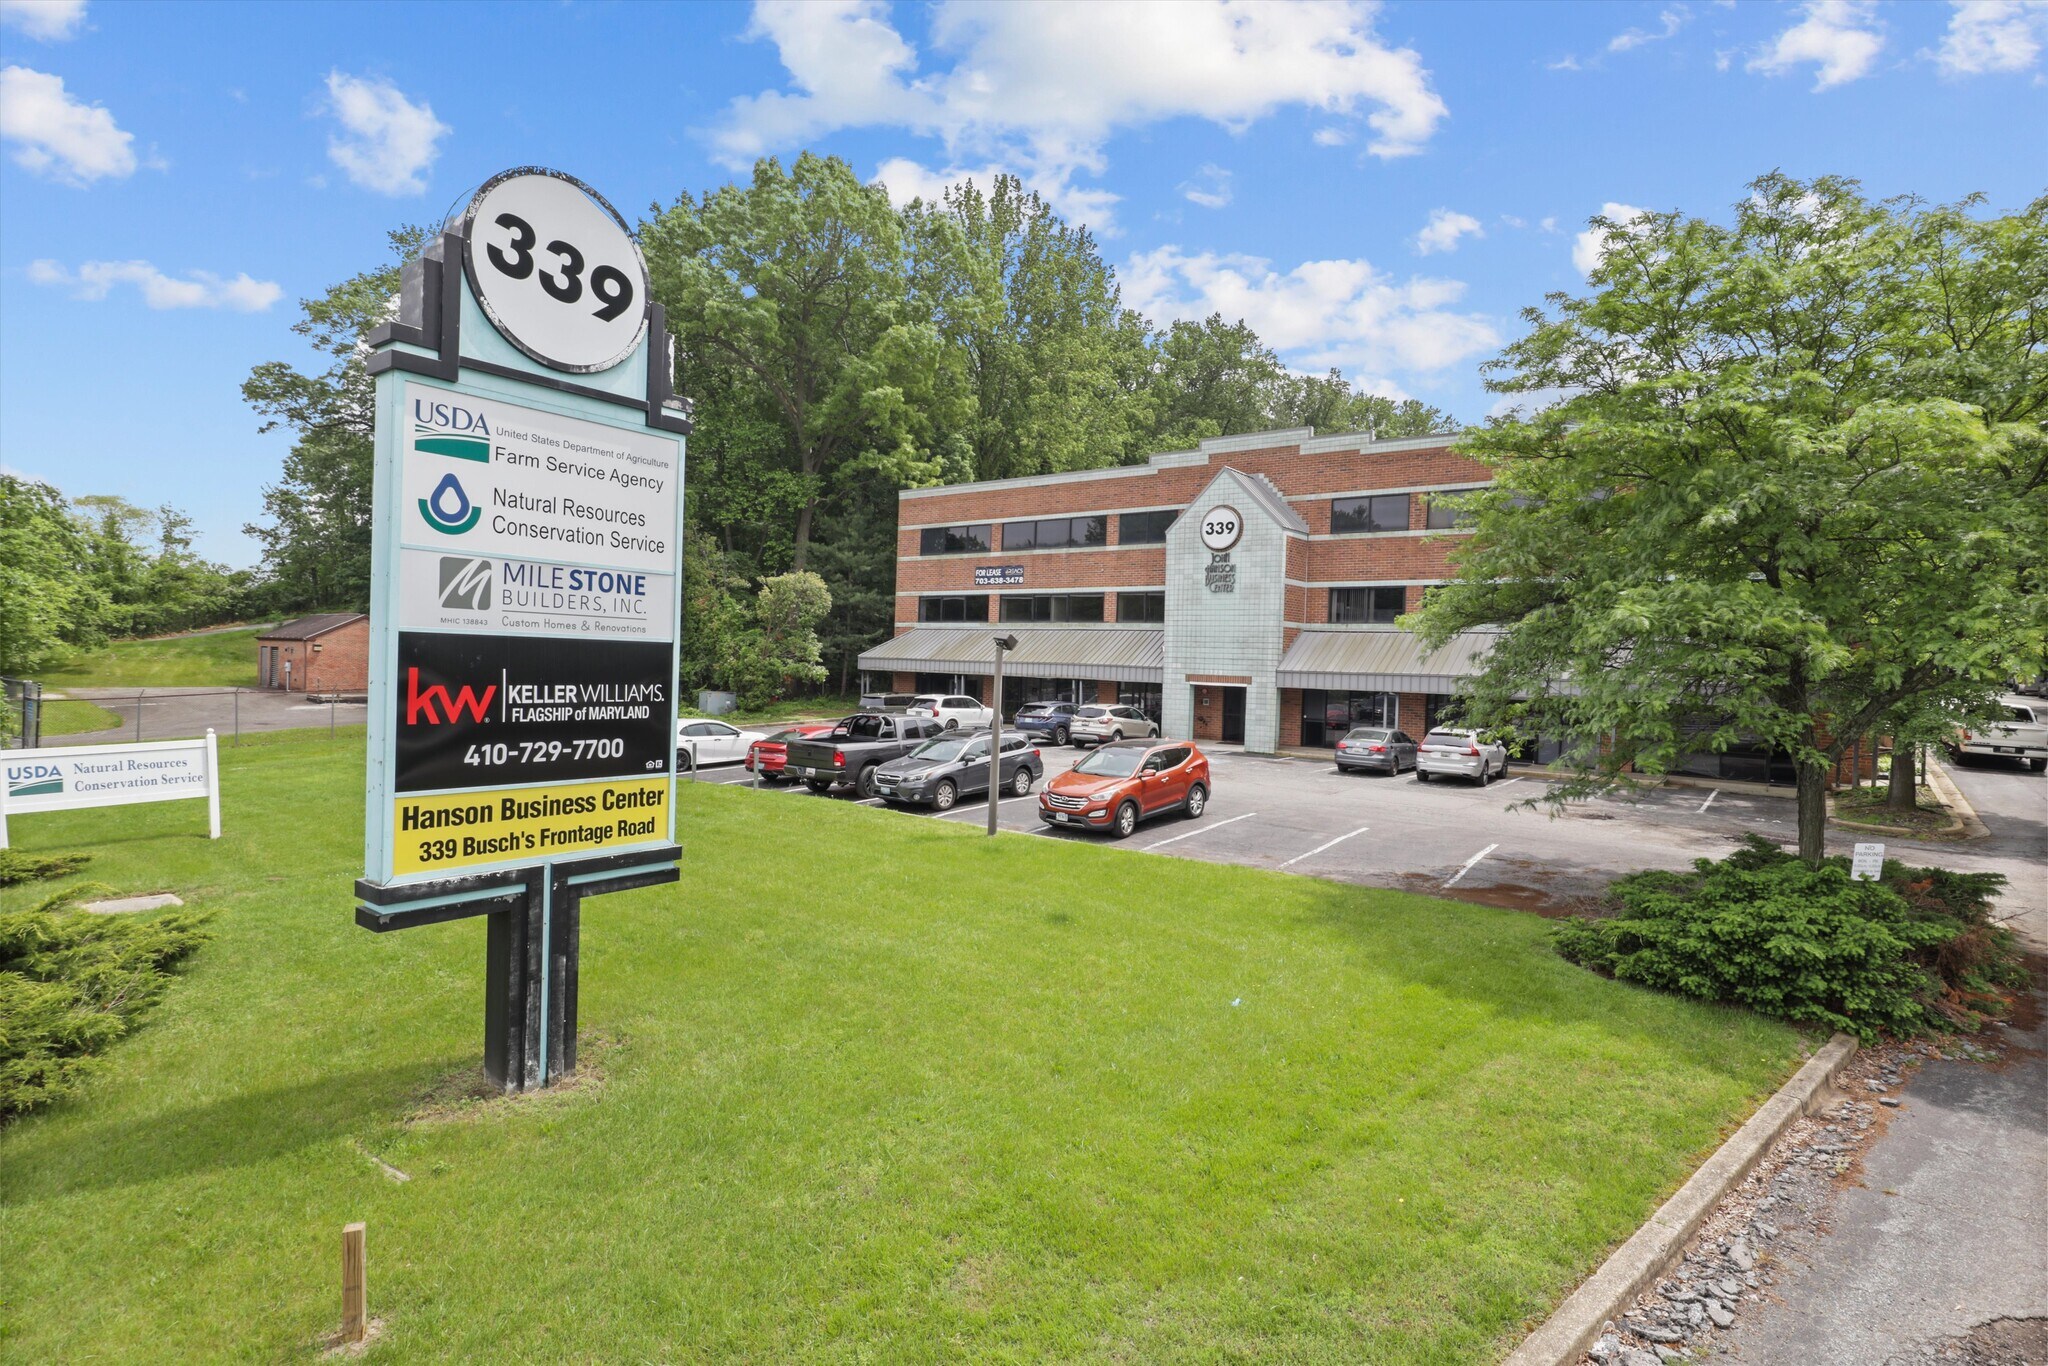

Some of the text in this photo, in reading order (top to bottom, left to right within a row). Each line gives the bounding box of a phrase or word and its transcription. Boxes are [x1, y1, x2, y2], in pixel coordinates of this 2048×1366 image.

[487, 213, 634, 322] 339
[415, 399, 491, 436] USDA
[496, 427, 669, 469] United States Department of Agriculture
[495, 447, 664, 493] Farm Service Agency
[493, 487, 646, 527] Natural Resources
[493, 515, 665, 554] Conservation Service
[1205, 521, 1235, 535] 339
[987, 568, 1001, 576] LEASE
[502, 590, 647, 615] BUILDERS, INC.
[440, 617, 488, 626] MHIC 138843
[502, 615, 646, 633] Custom Homes & Renovations
[508, 684, 577, 704] KELLER
[512, 705, 649, 722] FLAGSHIP of MARYLAND
[463, 738, 624, 766] 410-729-7700
[8, 765, 62, 780] USDA
[73, 758, 188, 775] Natural Resources
[74, 773, 204, 792] Conservation Service
[402, 787, 664, 831] Hanson Business Center
[419, 817, 655, 862] 339 Busch's Frontage Road
